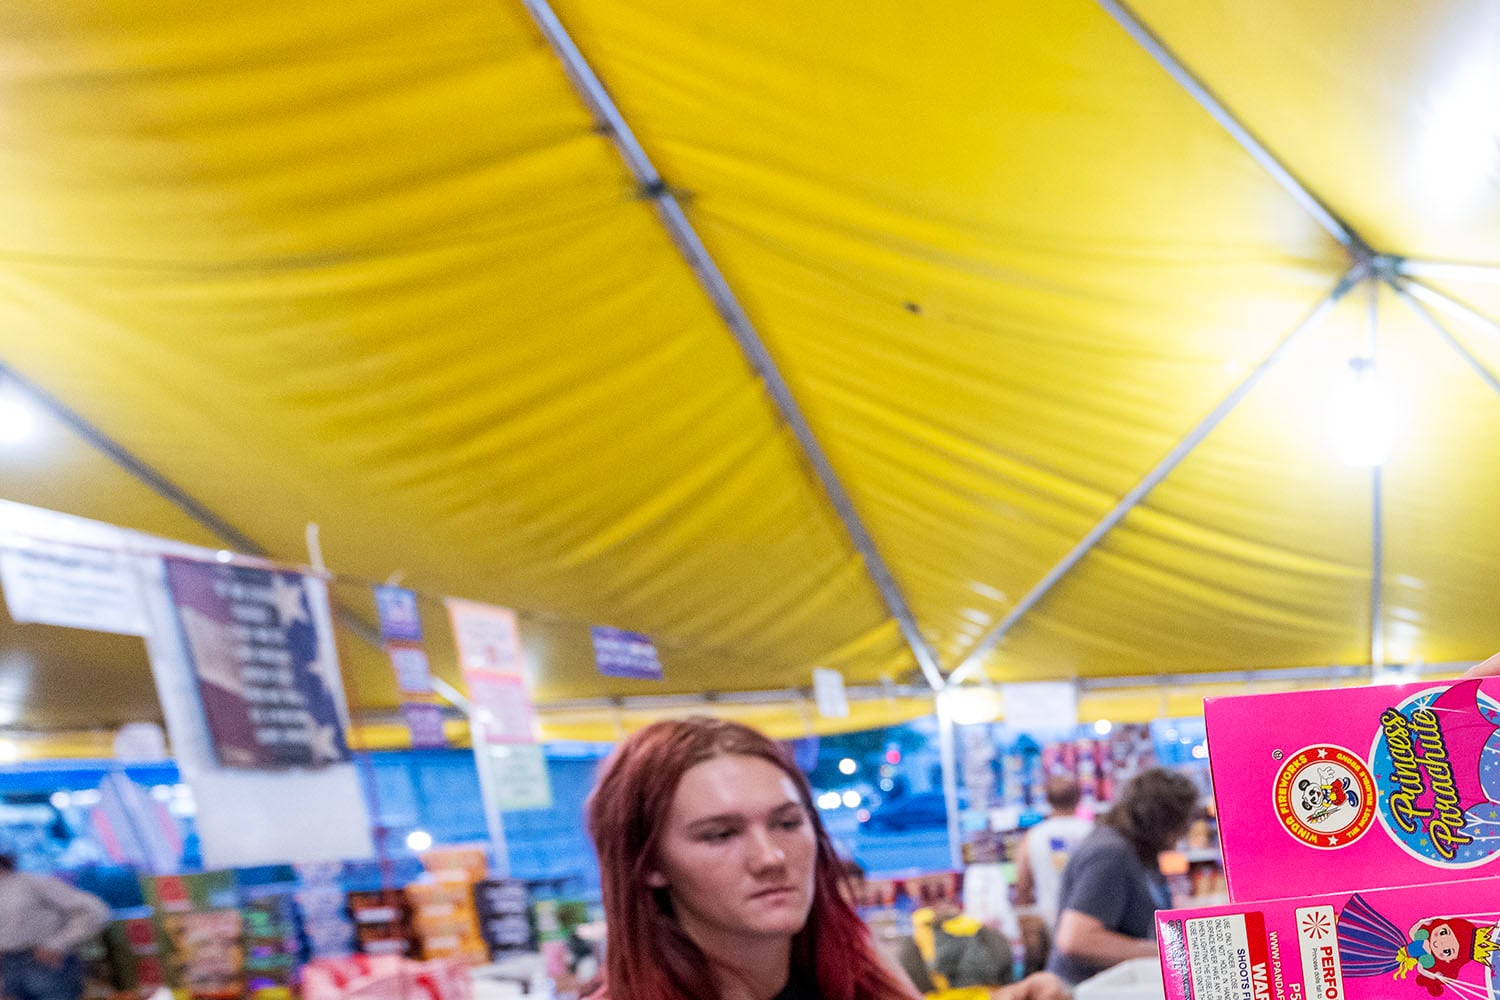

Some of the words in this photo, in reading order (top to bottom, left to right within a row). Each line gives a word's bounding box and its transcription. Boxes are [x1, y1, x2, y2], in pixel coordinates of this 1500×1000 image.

[1278, 755, 1307, 814] FIREWORKS
[1381, 709, 1432, 833] Princess
[1286, 816, 1318, 843] WINDA
[1236, 948, 1249, 989] SHOOTS
